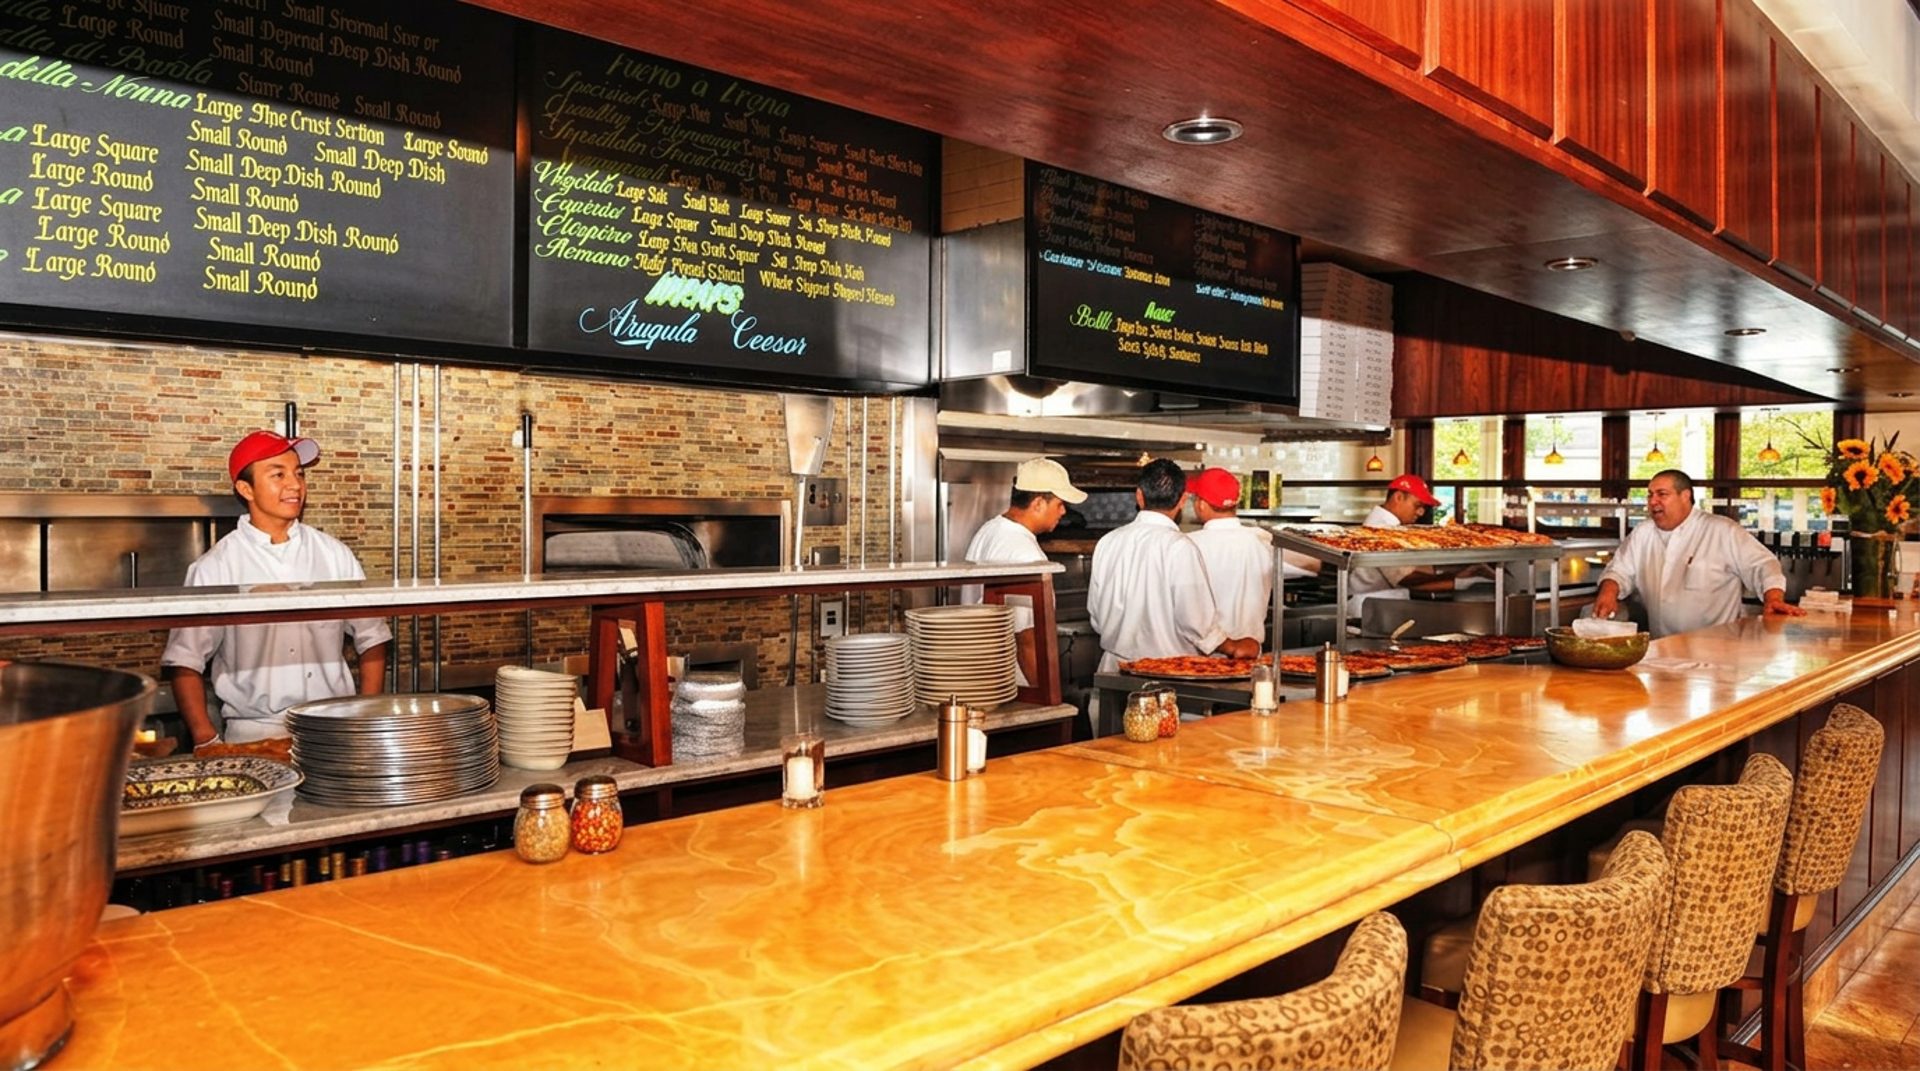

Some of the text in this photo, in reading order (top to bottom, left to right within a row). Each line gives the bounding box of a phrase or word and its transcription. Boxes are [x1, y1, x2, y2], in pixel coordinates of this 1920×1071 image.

[58, 4, 118, 39] Large
[124, 18, 185, 50] Round
[211, 8, 255, 37] Small
[209, 36, 254, 65] Small
[193, 92, 243, 123] Large
[403, 131, 443, 160] Large
[29, 123, 91, 157] Large
[96, 133, 159, 165] Square
[187, 119, 231, 147] Small
[236, 128, 288, 156] Round
[314, 141, 357, 168] Small
[361, 148, 404, 182] Deep
[29, 152, 86, 188] Large
[90, 162, 153, 193] Round
[185, 149, 233, 176] Small
[283, 163, 324, 190] Dish
[328, 171, 381, 199] Round
[31, 186, 92, 218] Large
[98, 193, 163, 224] Square
[191, 177, 240, 206] Small
[245, 186, 299, 213] Round
[34, 206, 399, 255] Large Round Small Deep Dish Round
[22, 237, 321, 283] Large Round Small Round
[202, 265, 318, 302] Small Round
[579, 298, 701, 351] Arugula
